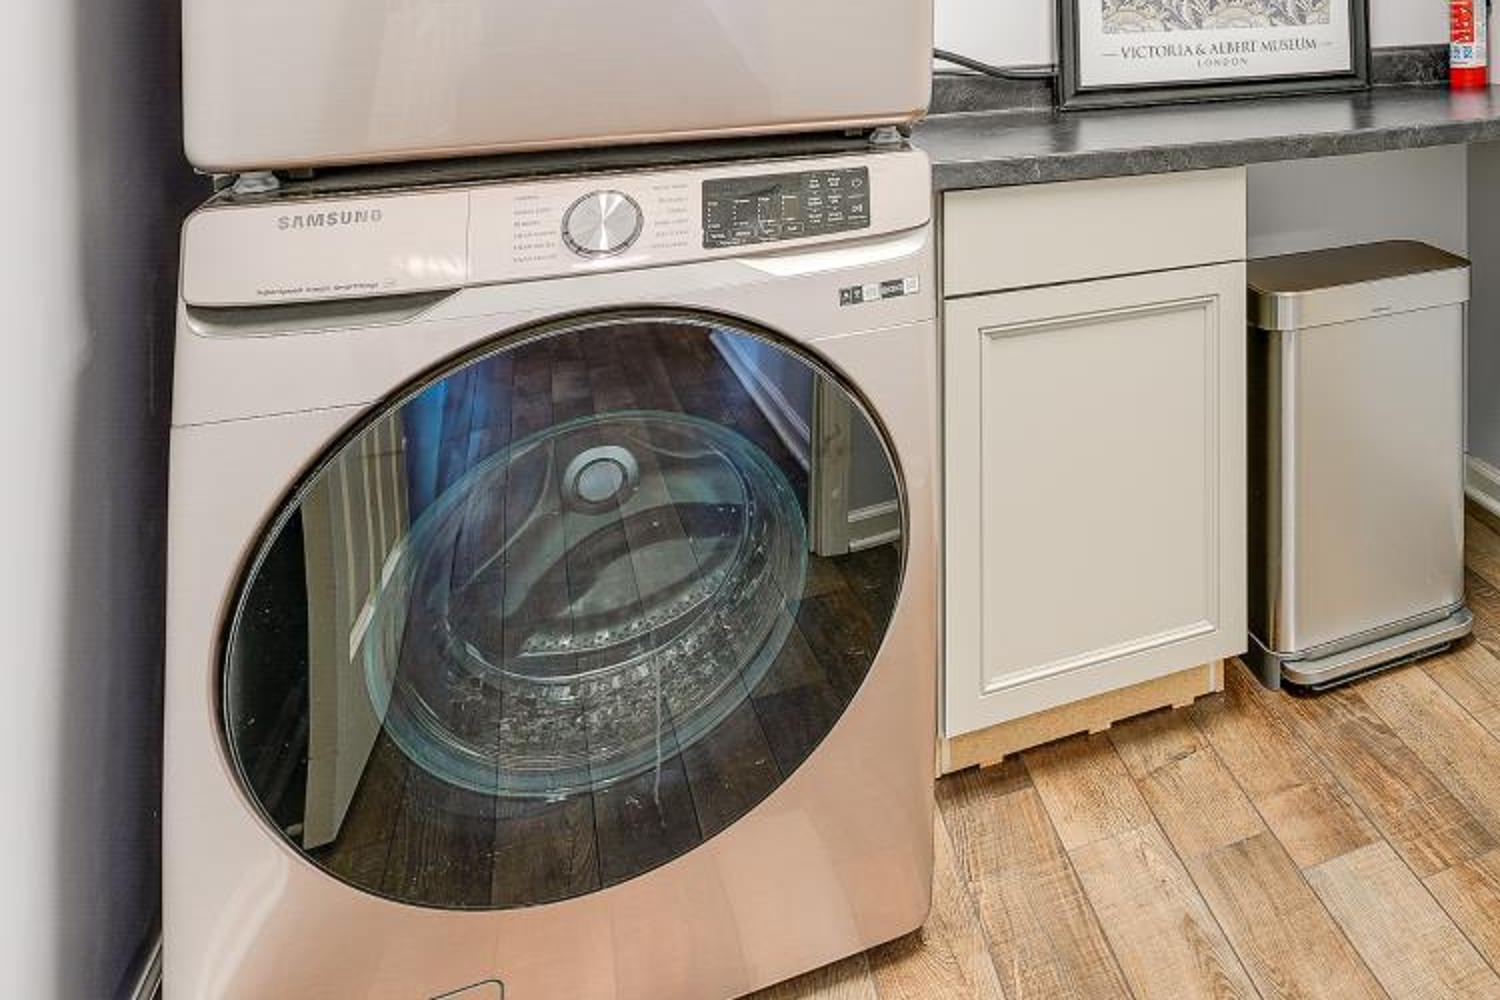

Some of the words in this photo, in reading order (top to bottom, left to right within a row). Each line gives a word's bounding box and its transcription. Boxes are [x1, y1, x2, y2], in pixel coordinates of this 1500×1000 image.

[1120, 43, 1194, 59] VICTORIA
[1195, 42, 1207, 56] &
[1209, 39, 1258, 55] ALBERT
[1260, 36, 1318, 52] MUSEUM
[1196, 57, 1249, 67] LONDON
[277, 209, 383, 231] SAMSUNG
